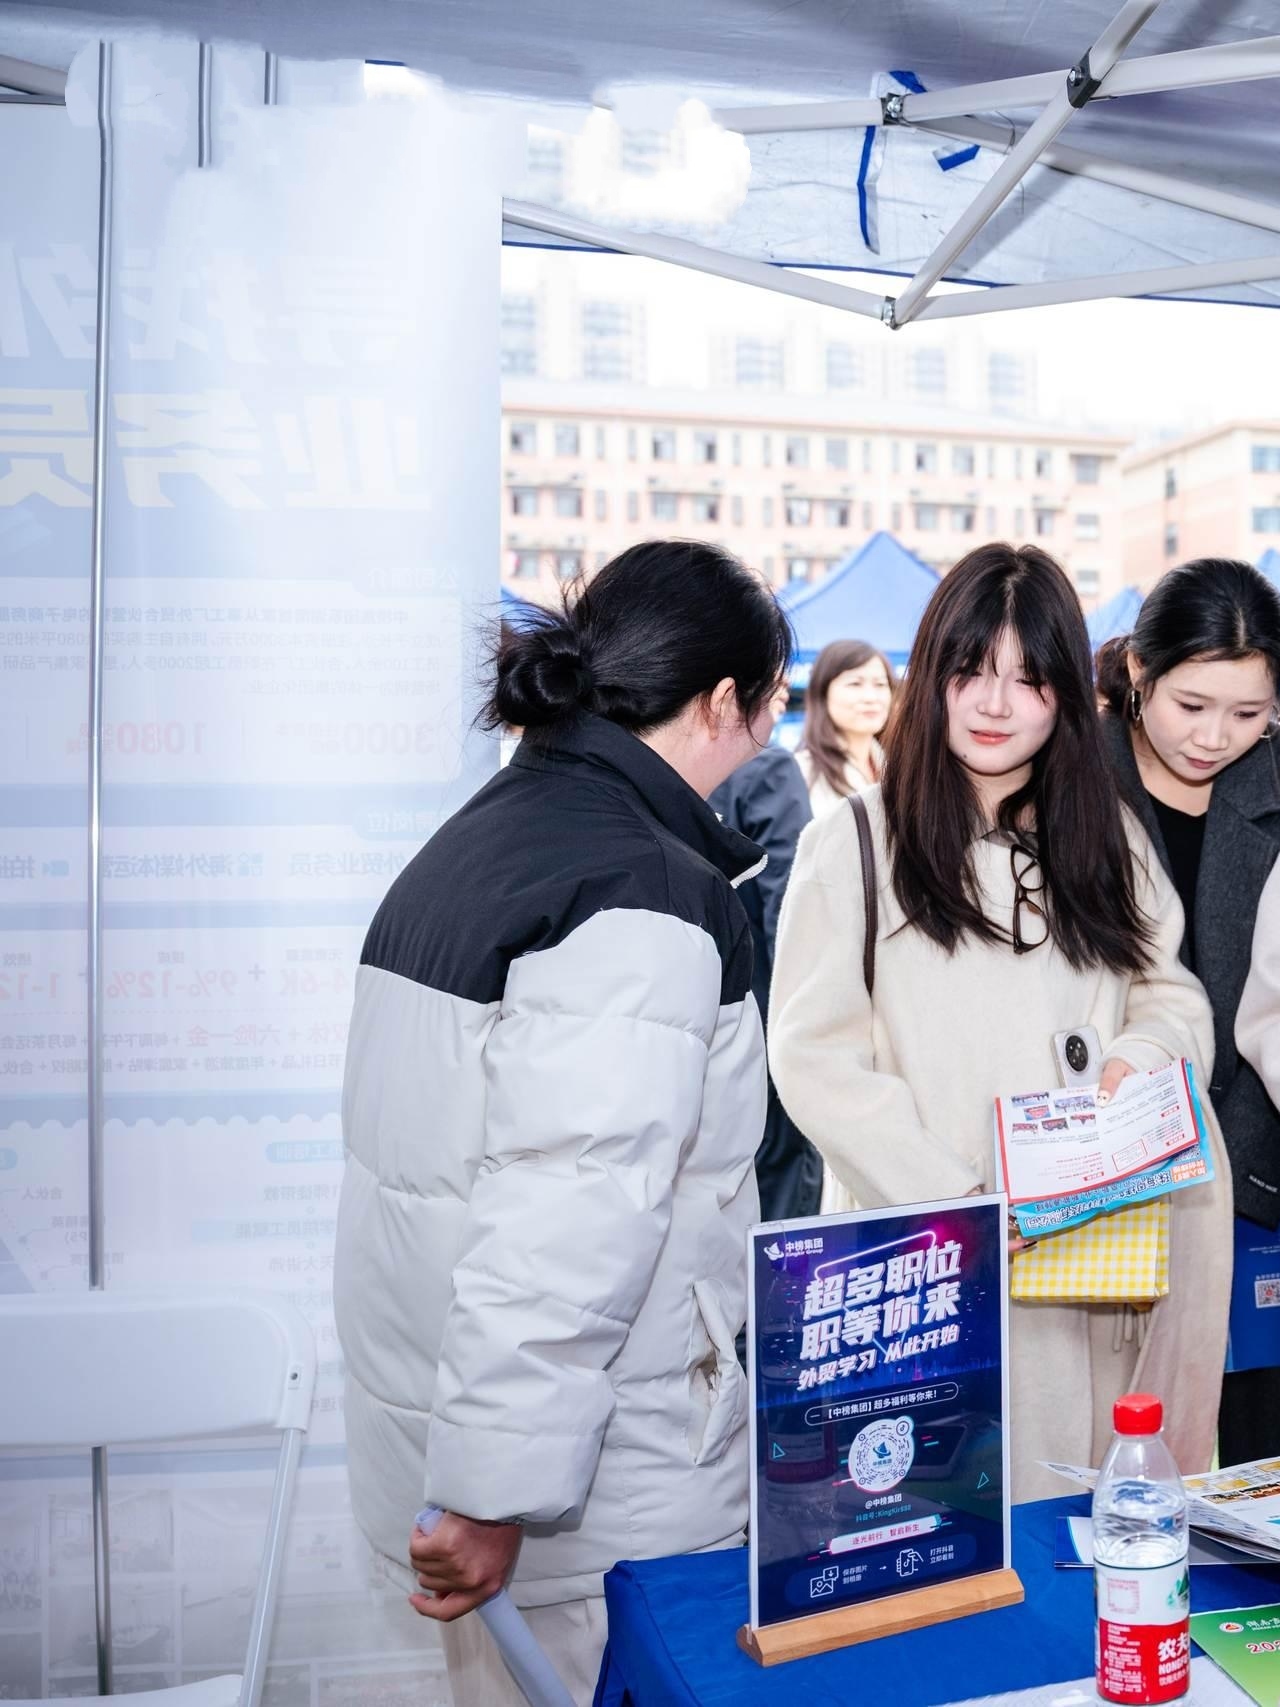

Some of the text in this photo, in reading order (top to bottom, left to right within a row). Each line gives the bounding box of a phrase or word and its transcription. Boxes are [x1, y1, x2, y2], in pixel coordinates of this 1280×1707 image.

[803, 1240, 963, 1321] 超多职位
[797, 1323, 961, 1391] 外贸学习 从此开始
[800, 1281, 962, 1361] 职等你来
